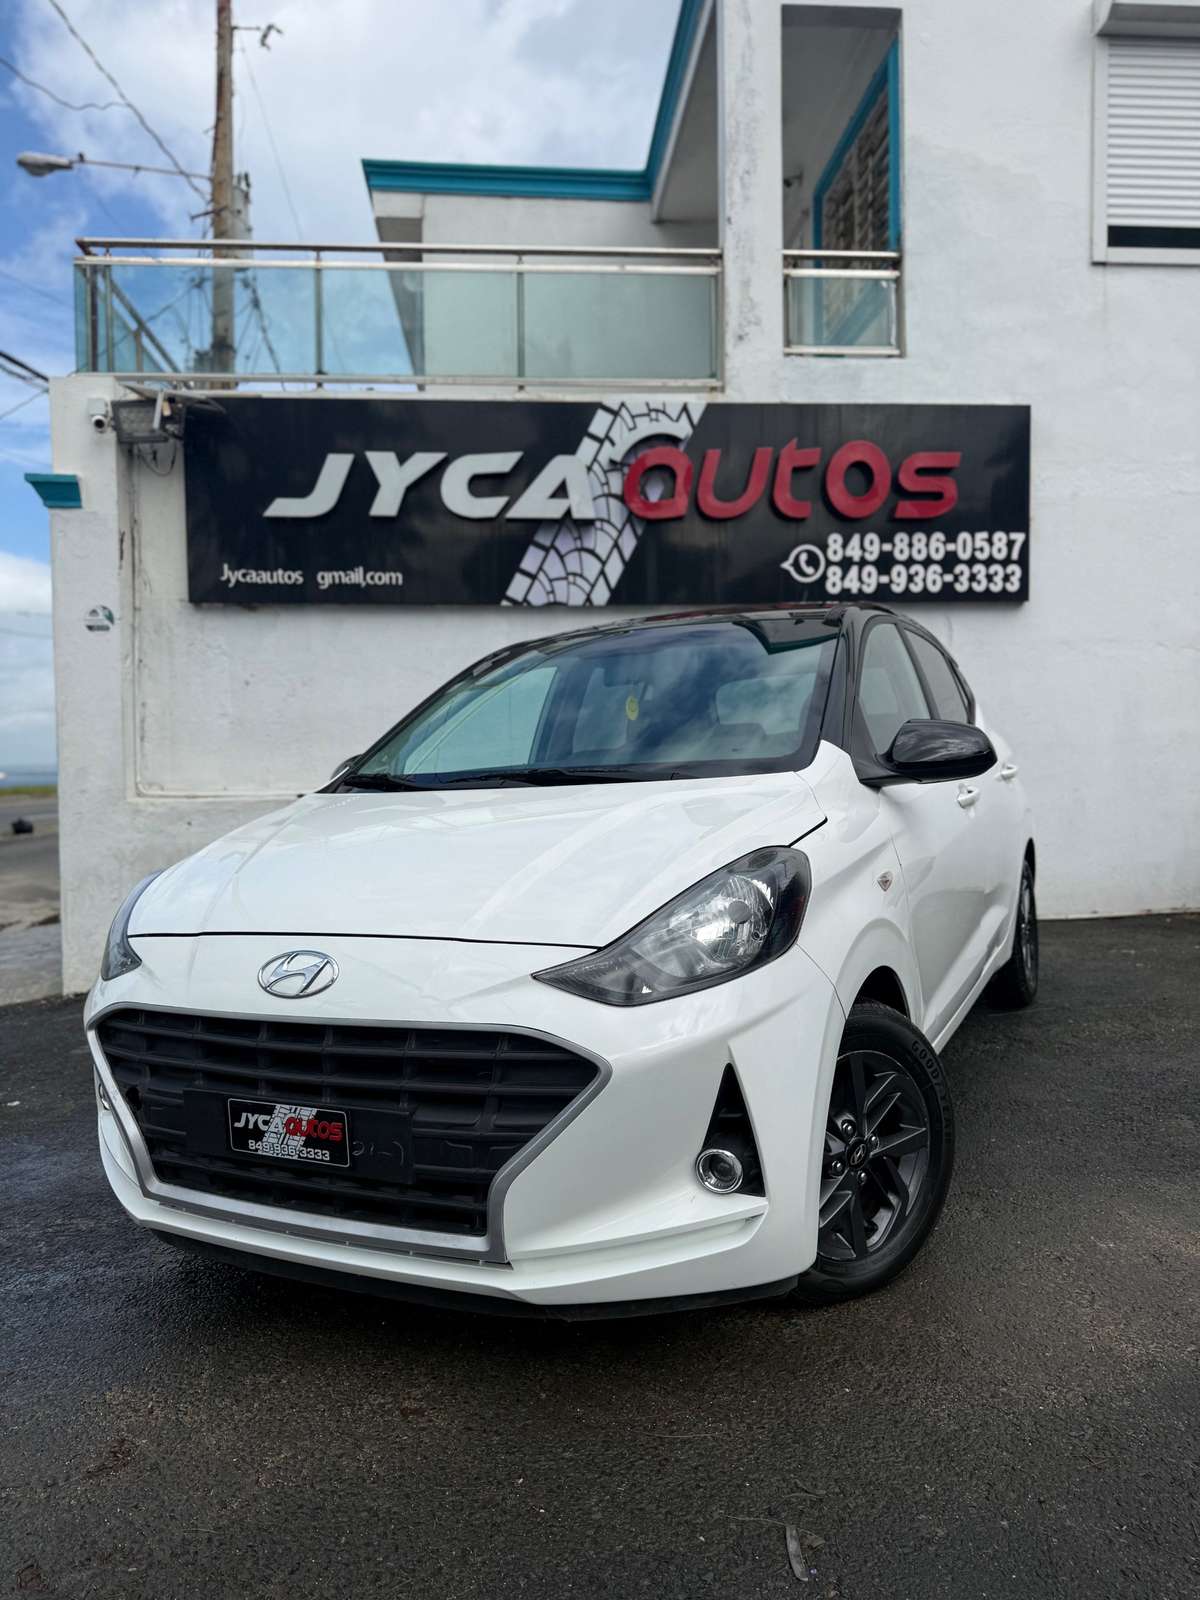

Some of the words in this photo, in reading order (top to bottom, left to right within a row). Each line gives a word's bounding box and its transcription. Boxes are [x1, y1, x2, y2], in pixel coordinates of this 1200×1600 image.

[262, 450, 596, 520] JYCA
[825, 531, 1026, 562] 849-886-0587
[219, 562, 305, 589] Jycaautos
[824, 562, 1023, 594] 849-936-3333
[233, 1111, 285, 1134] JYCA
[247, 1139, 331, 1161] 849-936-3333
